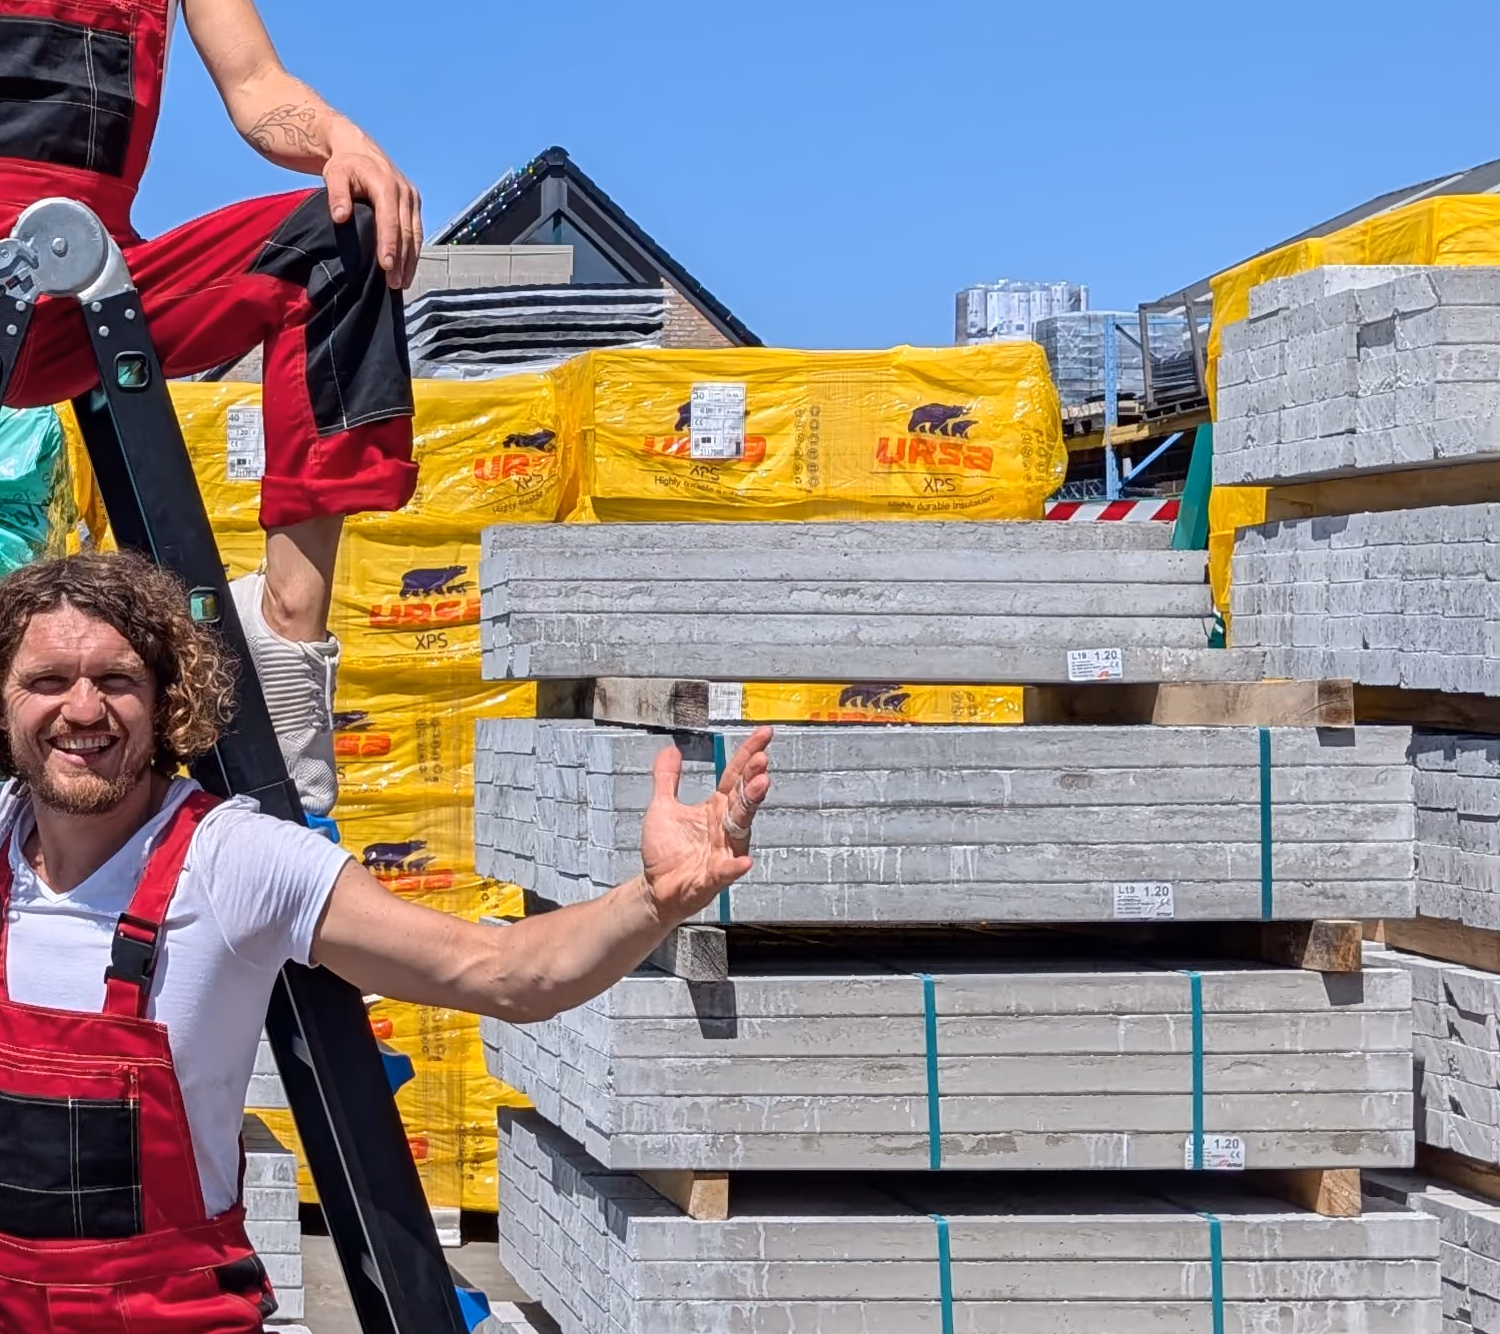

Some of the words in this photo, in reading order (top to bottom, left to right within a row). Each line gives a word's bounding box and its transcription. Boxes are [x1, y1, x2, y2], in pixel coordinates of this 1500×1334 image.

[515, 471, 544, 493] XPS
[654, 475, 681, 488] Highly
[923, 477, 956, 493] XPS
[916, 500, 950, 511] durable
[952, 493, 995, 510] insulation
[415, 632, 448, 651] XPS
[1094, 649, 1118, 661] 1.20
[1144, 885, 1170, 897] 1.20
[1213, 1138, 1240, 1149] 1.20
